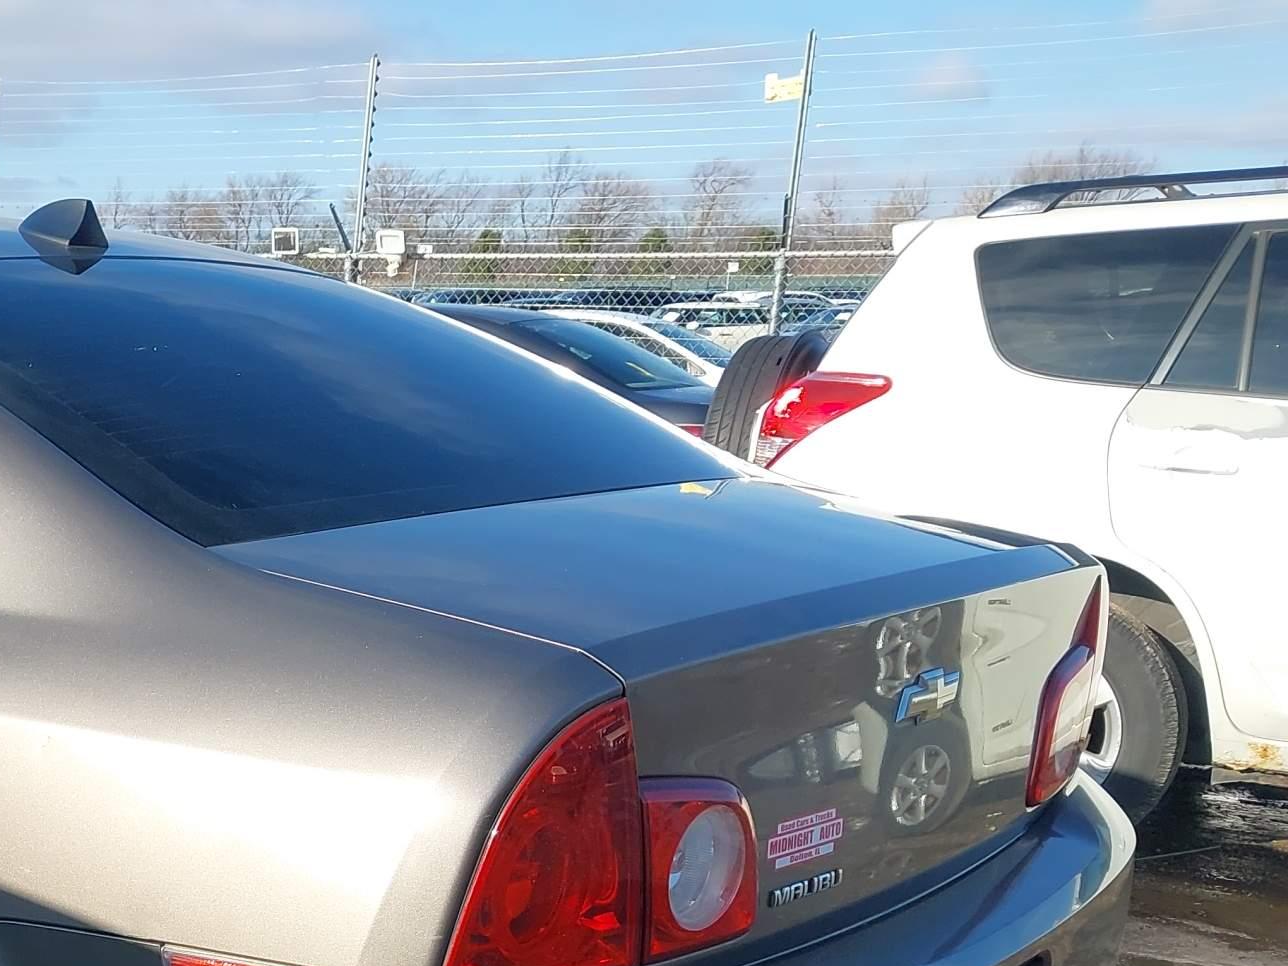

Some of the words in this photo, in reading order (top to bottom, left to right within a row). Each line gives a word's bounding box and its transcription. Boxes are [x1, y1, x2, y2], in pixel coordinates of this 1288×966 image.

[769, 829, 815, 856] MIDNIGHT
[819, 821, 842, 840] AUTO
[796, 818, 810, 828] Cars
[772, 868, 843, 907] MALIBU
